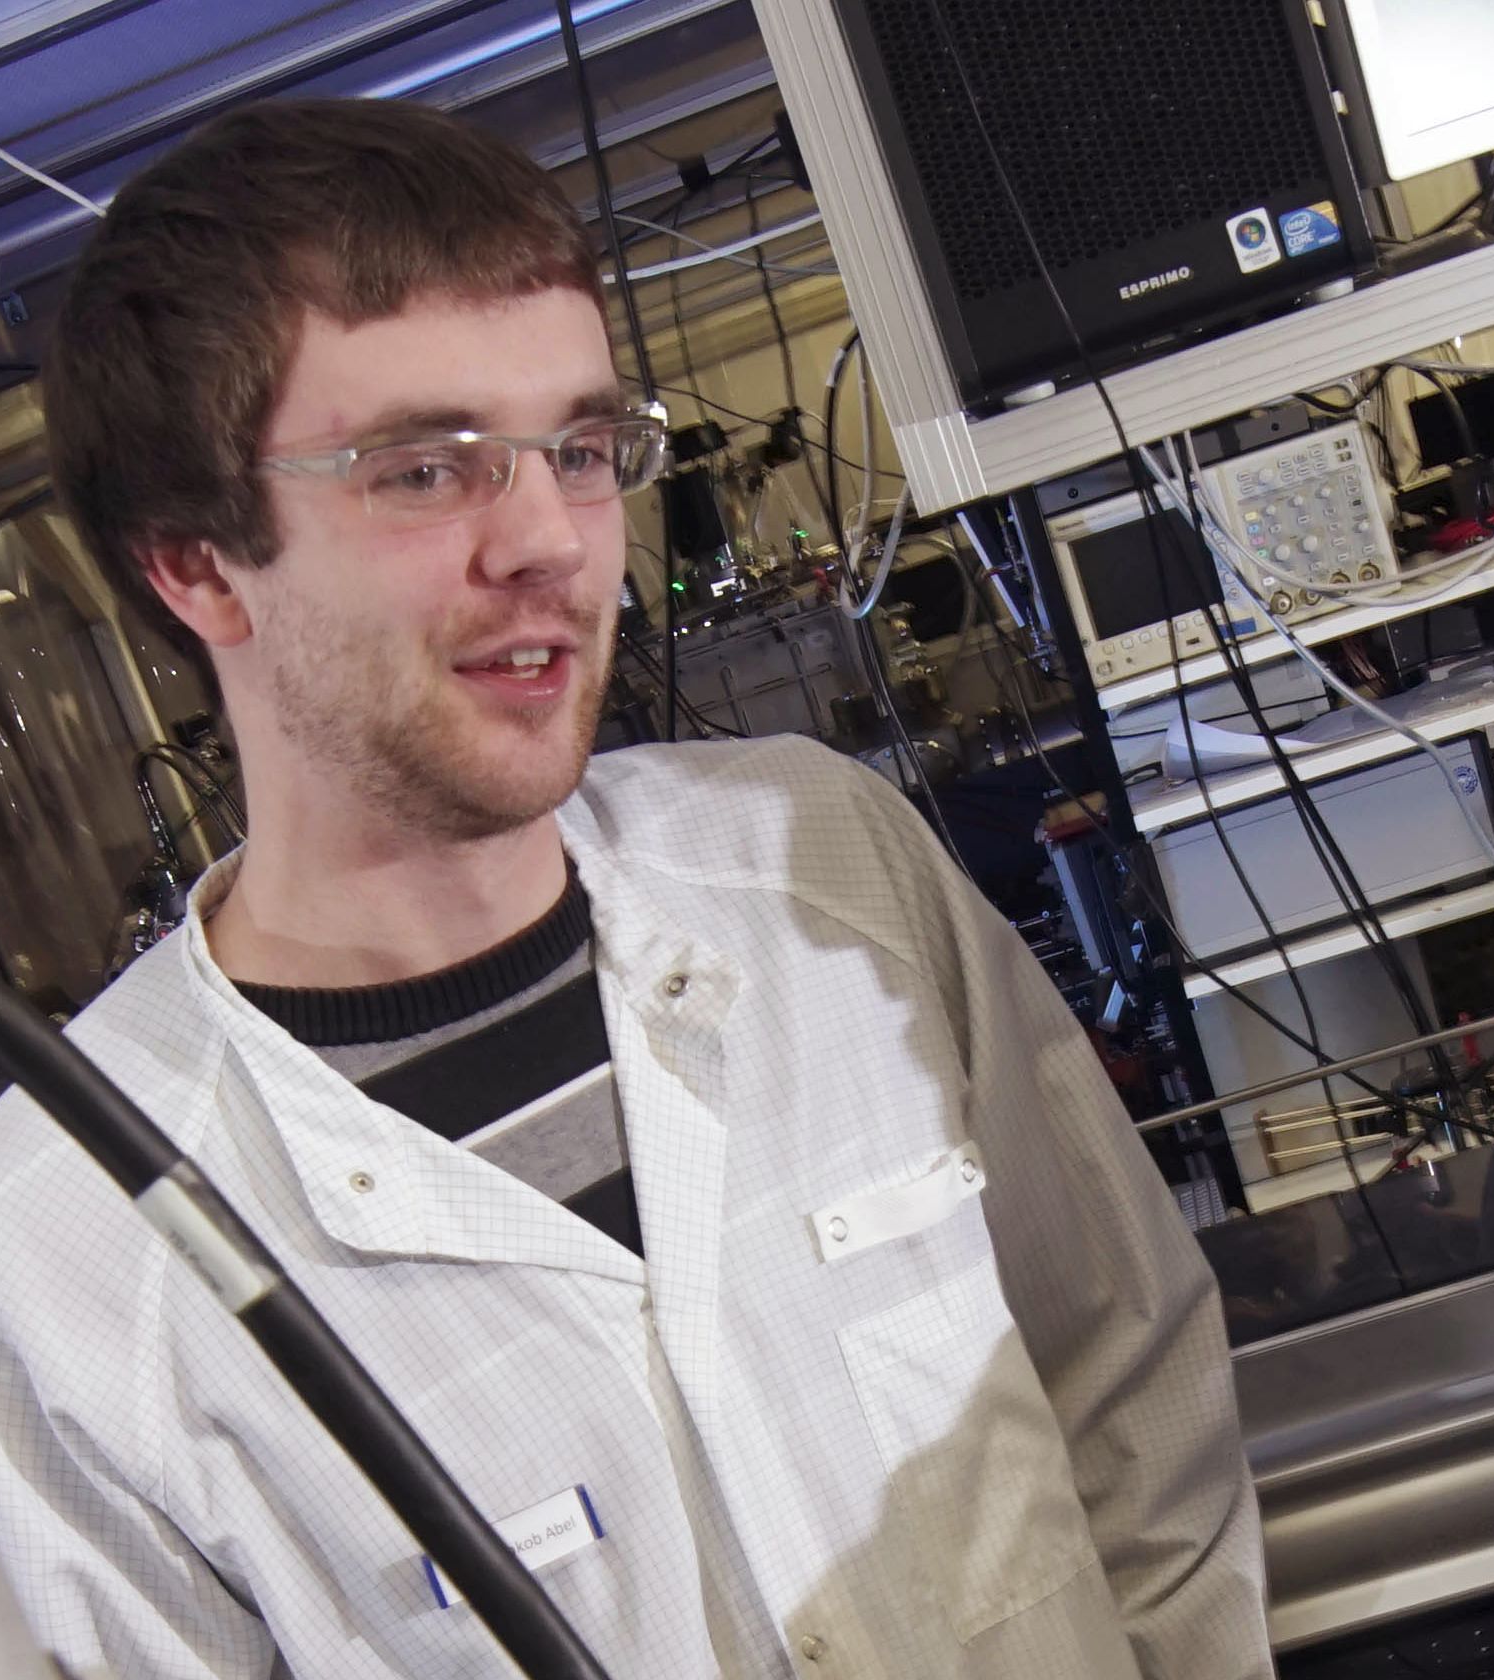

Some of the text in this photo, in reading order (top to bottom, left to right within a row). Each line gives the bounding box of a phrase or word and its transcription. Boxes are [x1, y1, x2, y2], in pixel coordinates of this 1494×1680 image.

[1118, 265, 1191, 300] ESPRIMO
[513, 1515, 578, 1553] kob Abel
